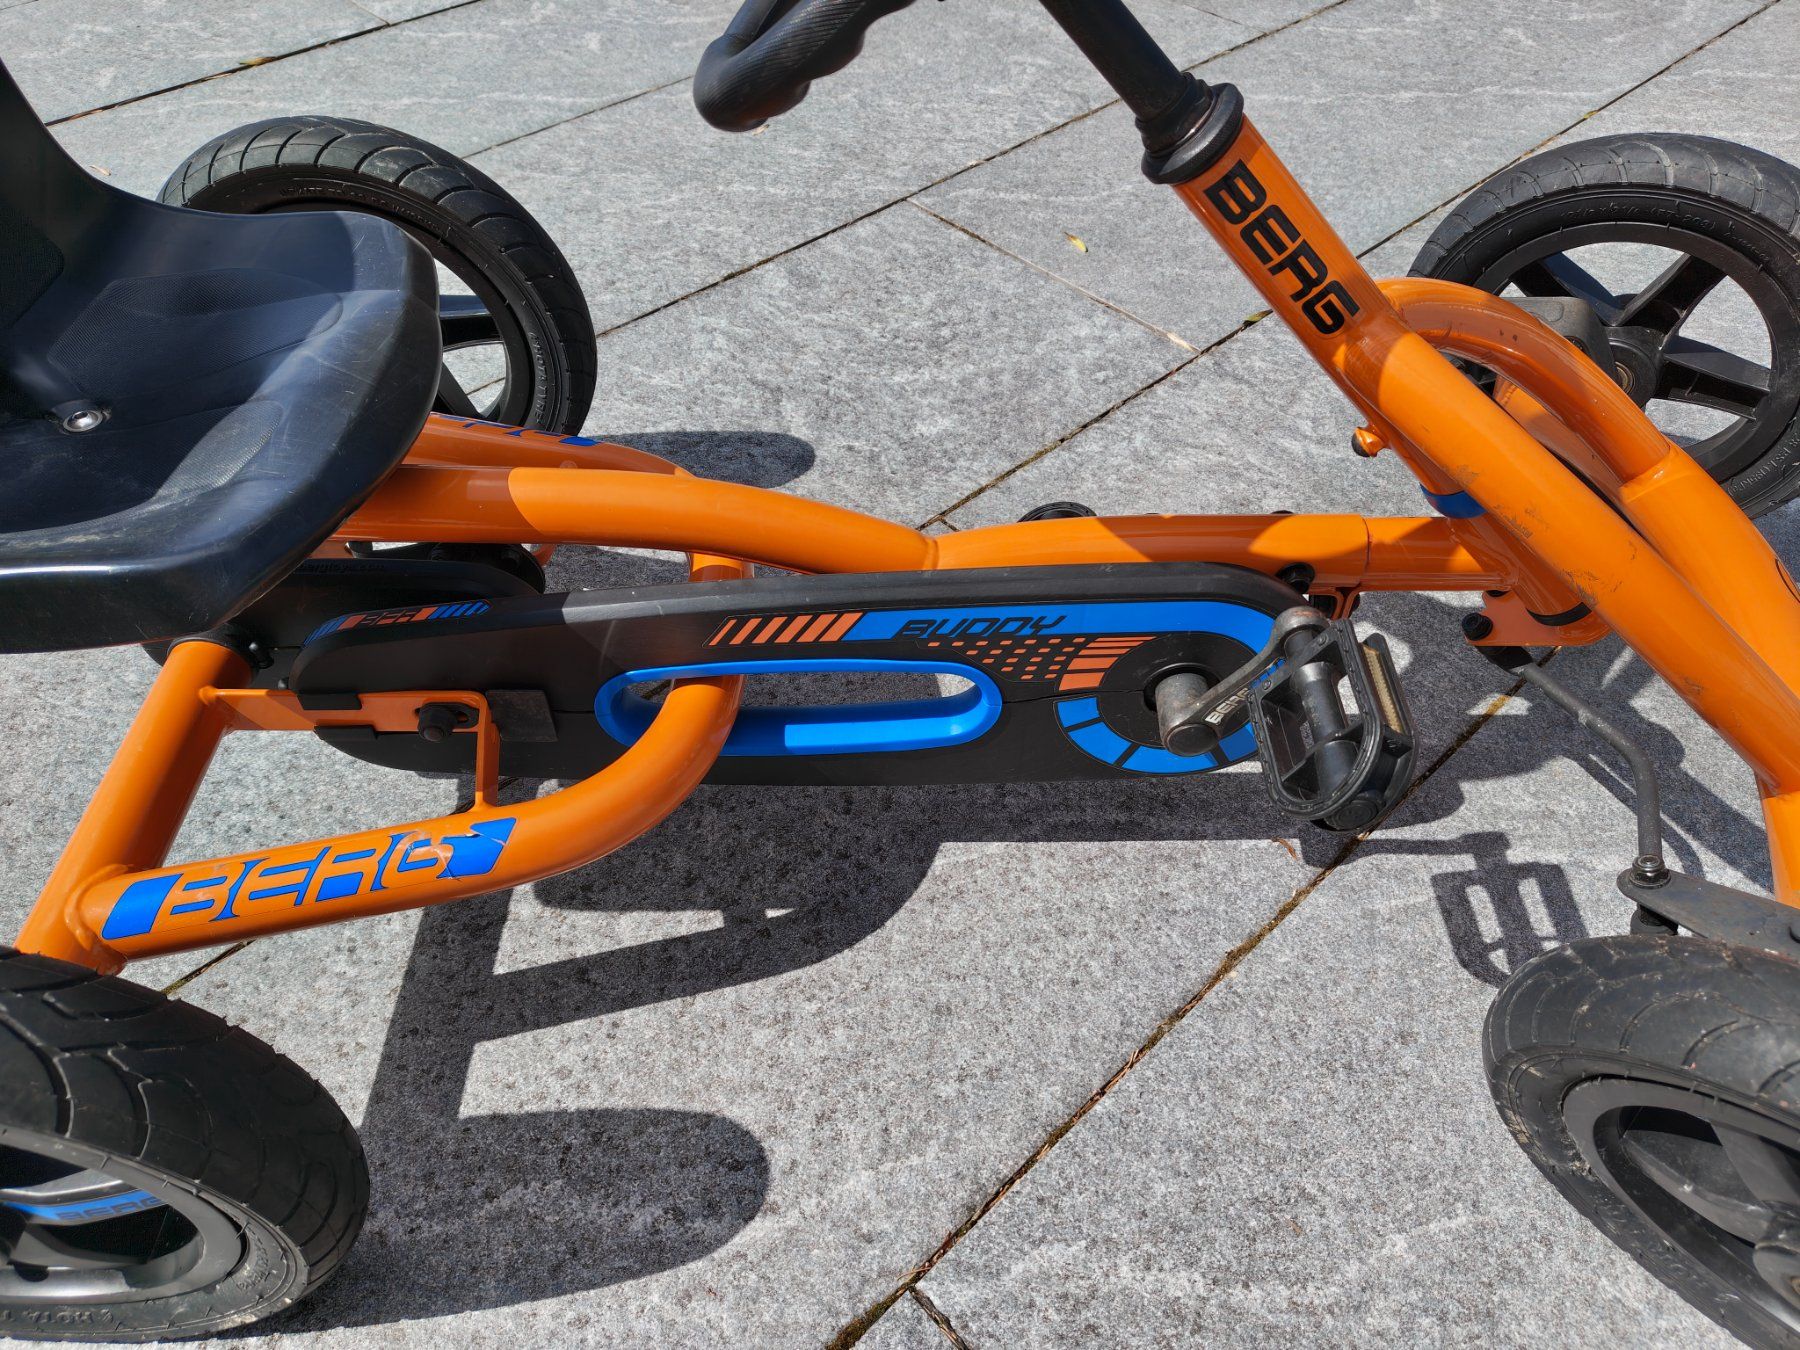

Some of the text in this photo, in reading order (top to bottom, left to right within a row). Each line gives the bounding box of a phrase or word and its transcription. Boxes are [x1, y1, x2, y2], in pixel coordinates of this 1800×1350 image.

[1203, 159, 1360, 335] BERG
[891, 615, 1067, 639] BUDDY
[148, 831, 458, 934] BERG
[55, 1194, 162, 1221] BERG
